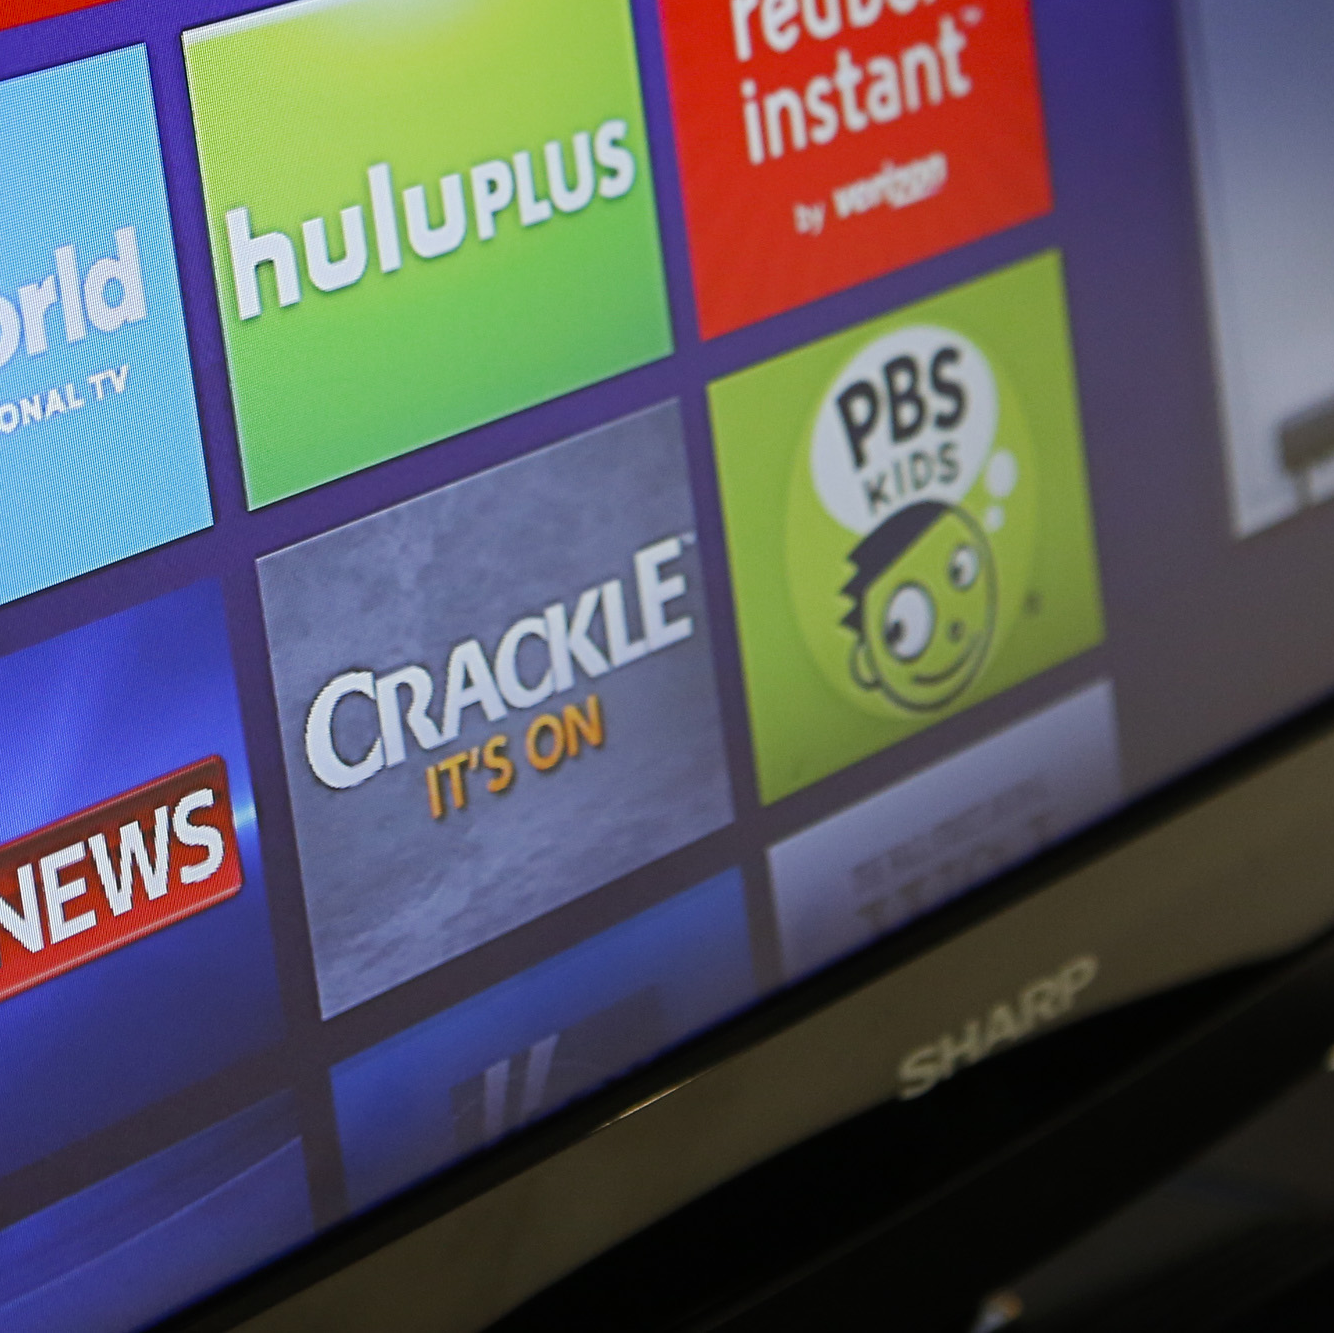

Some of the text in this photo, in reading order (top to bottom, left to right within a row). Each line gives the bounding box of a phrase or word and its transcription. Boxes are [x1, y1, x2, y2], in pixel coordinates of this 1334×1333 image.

[741, 14, 972, 165] instant
[87, 364, 129, 400] TV
[835, 345, 965, 470] PBS
[861, 440, 962, 517] KIDS
[304, 536, 695, 790] CRACKLE
[425, 693, 604, 819] IT'S ON
[897, 954, 1099, 1101] SHARP
